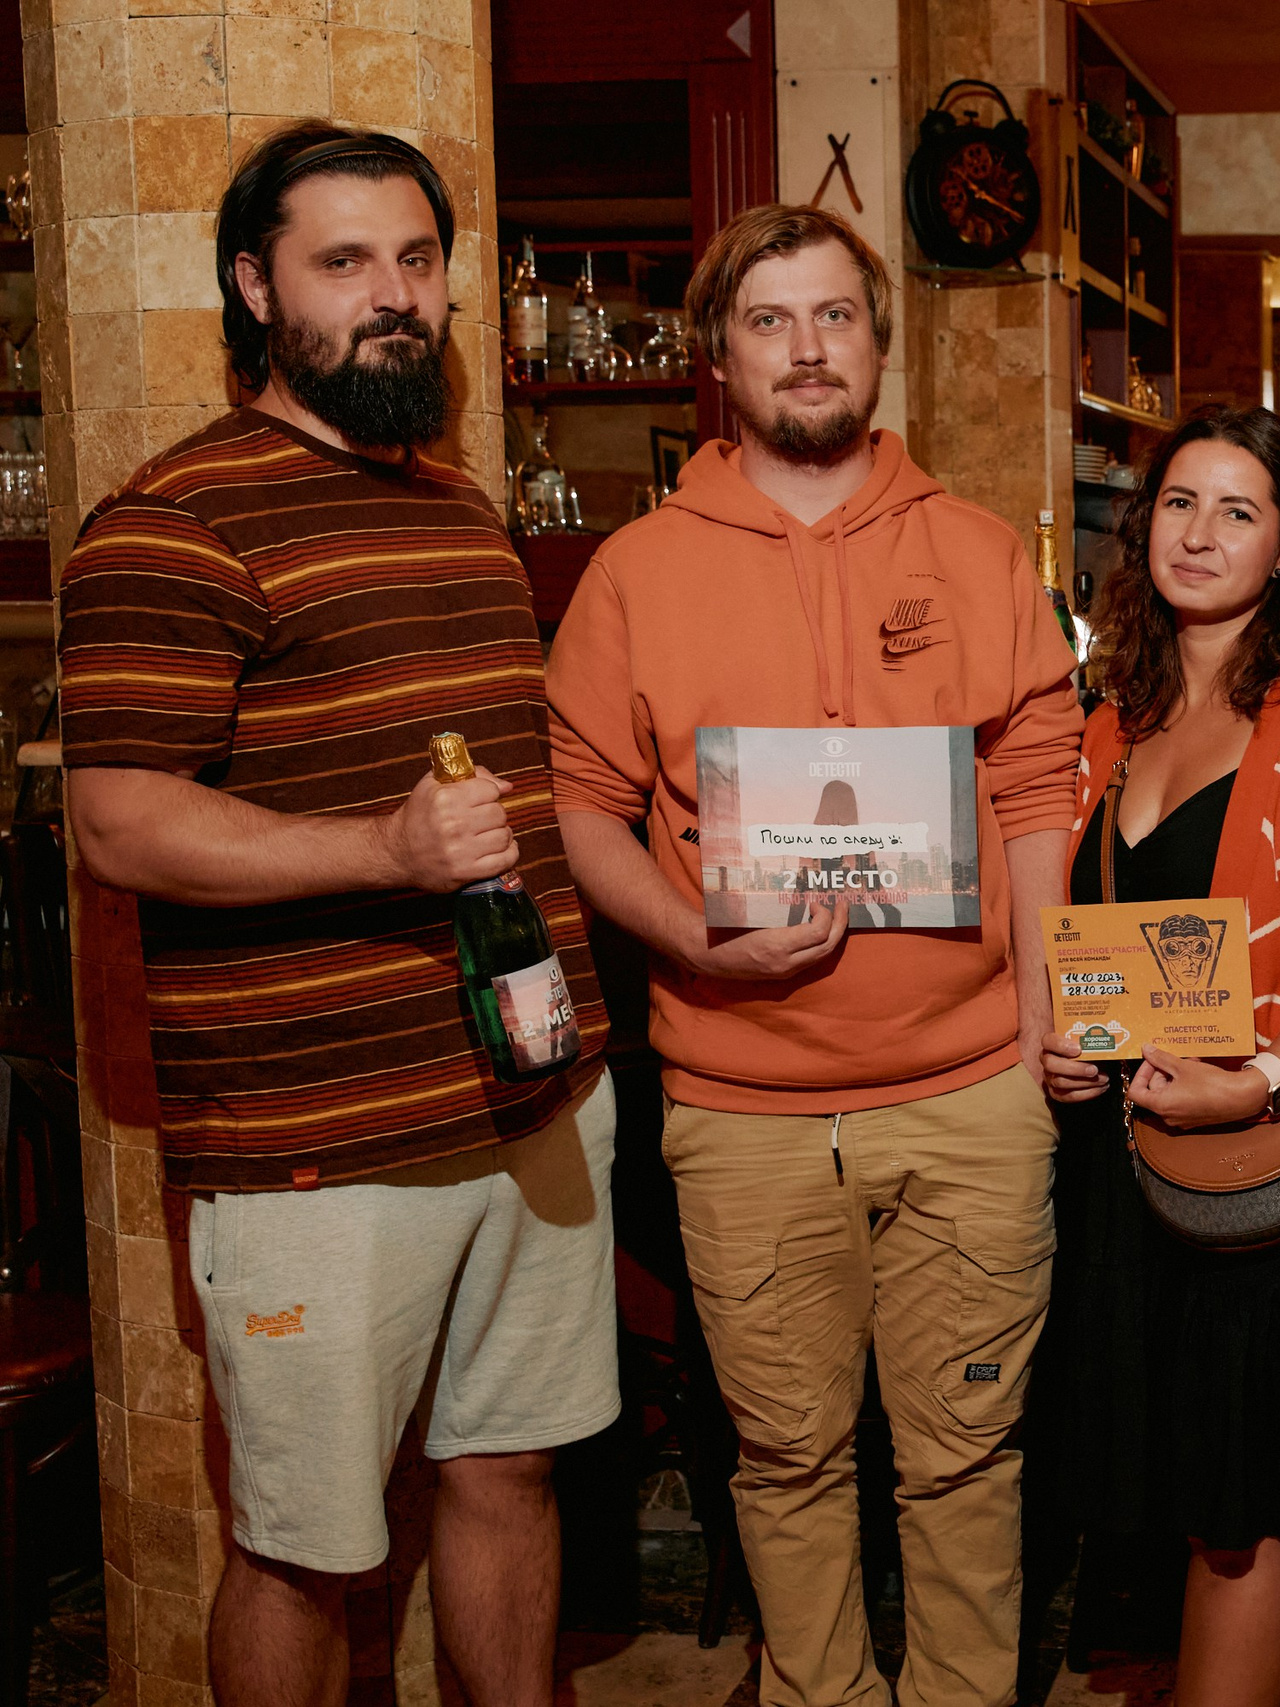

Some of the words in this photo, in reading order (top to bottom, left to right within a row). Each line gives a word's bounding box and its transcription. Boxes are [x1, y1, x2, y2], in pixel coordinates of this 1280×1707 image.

[809, 762, 862, 777] DETECTIT
[761, 829, 813, 844] Пошли
[820, 836, 838, 845] по
[843, 836, 884, 850] следу
[783, 871, 797, 889] 2
[808, 870, 899, 889] МЕСТО
[1054, 932, 1081, 942] DETECTIT
[1057, 946, 1109, 956] БЕСПЛАТНОЕ
[1111, 945, 1147, 954] УЧАСТИЕ
[1150, 989, 1231, 1008] БУНКЕР
[521, 1020, 537, 1038] 2
[1164, 1025, 1202, 1034] СПАСЕТСЯ
[1204, 1025, 1220, 1033] ТОТ,
[1168, 1036, 1192, 1044] УМЕЕТ
[1194, 1035, 1235, 1044] УБЕЖДАТЬ
